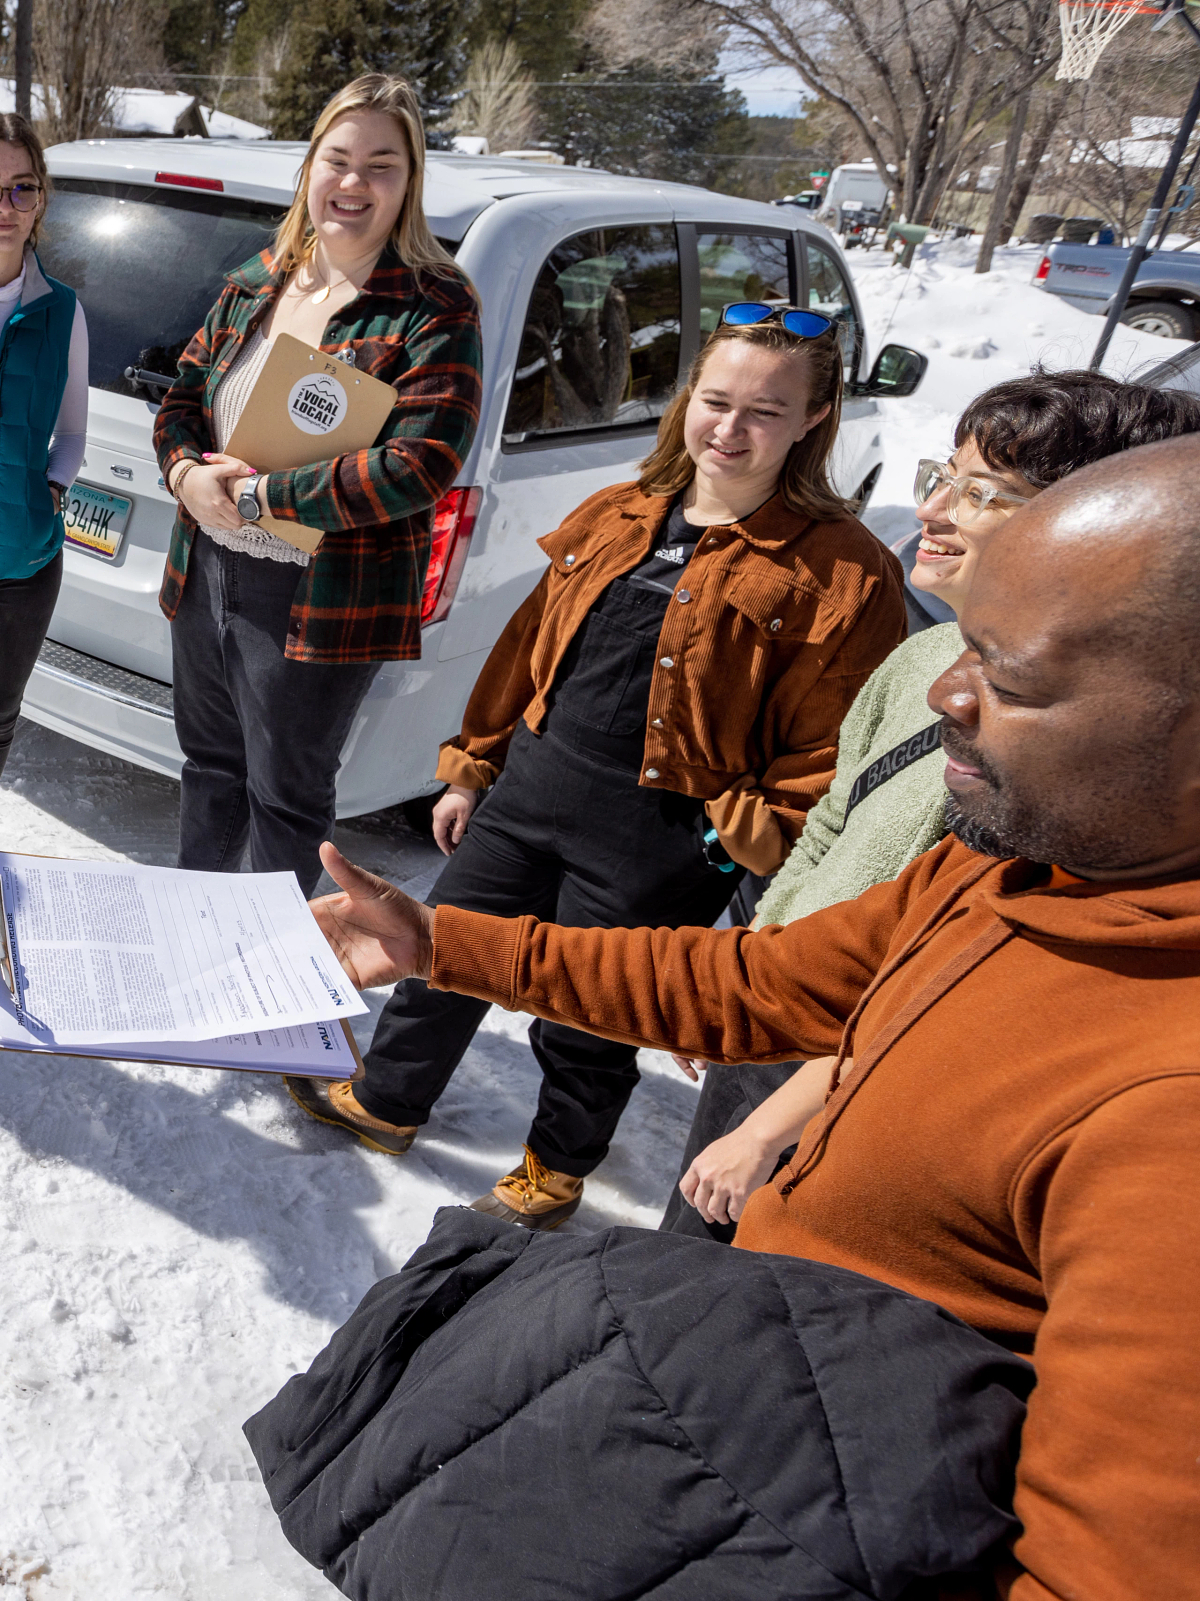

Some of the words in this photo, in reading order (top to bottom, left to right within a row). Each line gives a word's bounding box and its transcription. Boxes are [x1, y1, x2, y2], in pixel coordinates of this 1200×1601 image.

[292, 398, 335, 427] LOCAL!
[303, 390, 339, 416] VOCAL
[70, 487, 106, 504] IZONA
[655, 549, 684, 564] adidas
[866, 722, 941, 791] BAGGU
[310, 956, 320, 971] ARIZONA
[327, 988, 345, 1006] NAU
[317, 1026, 334, 1050] NAU
